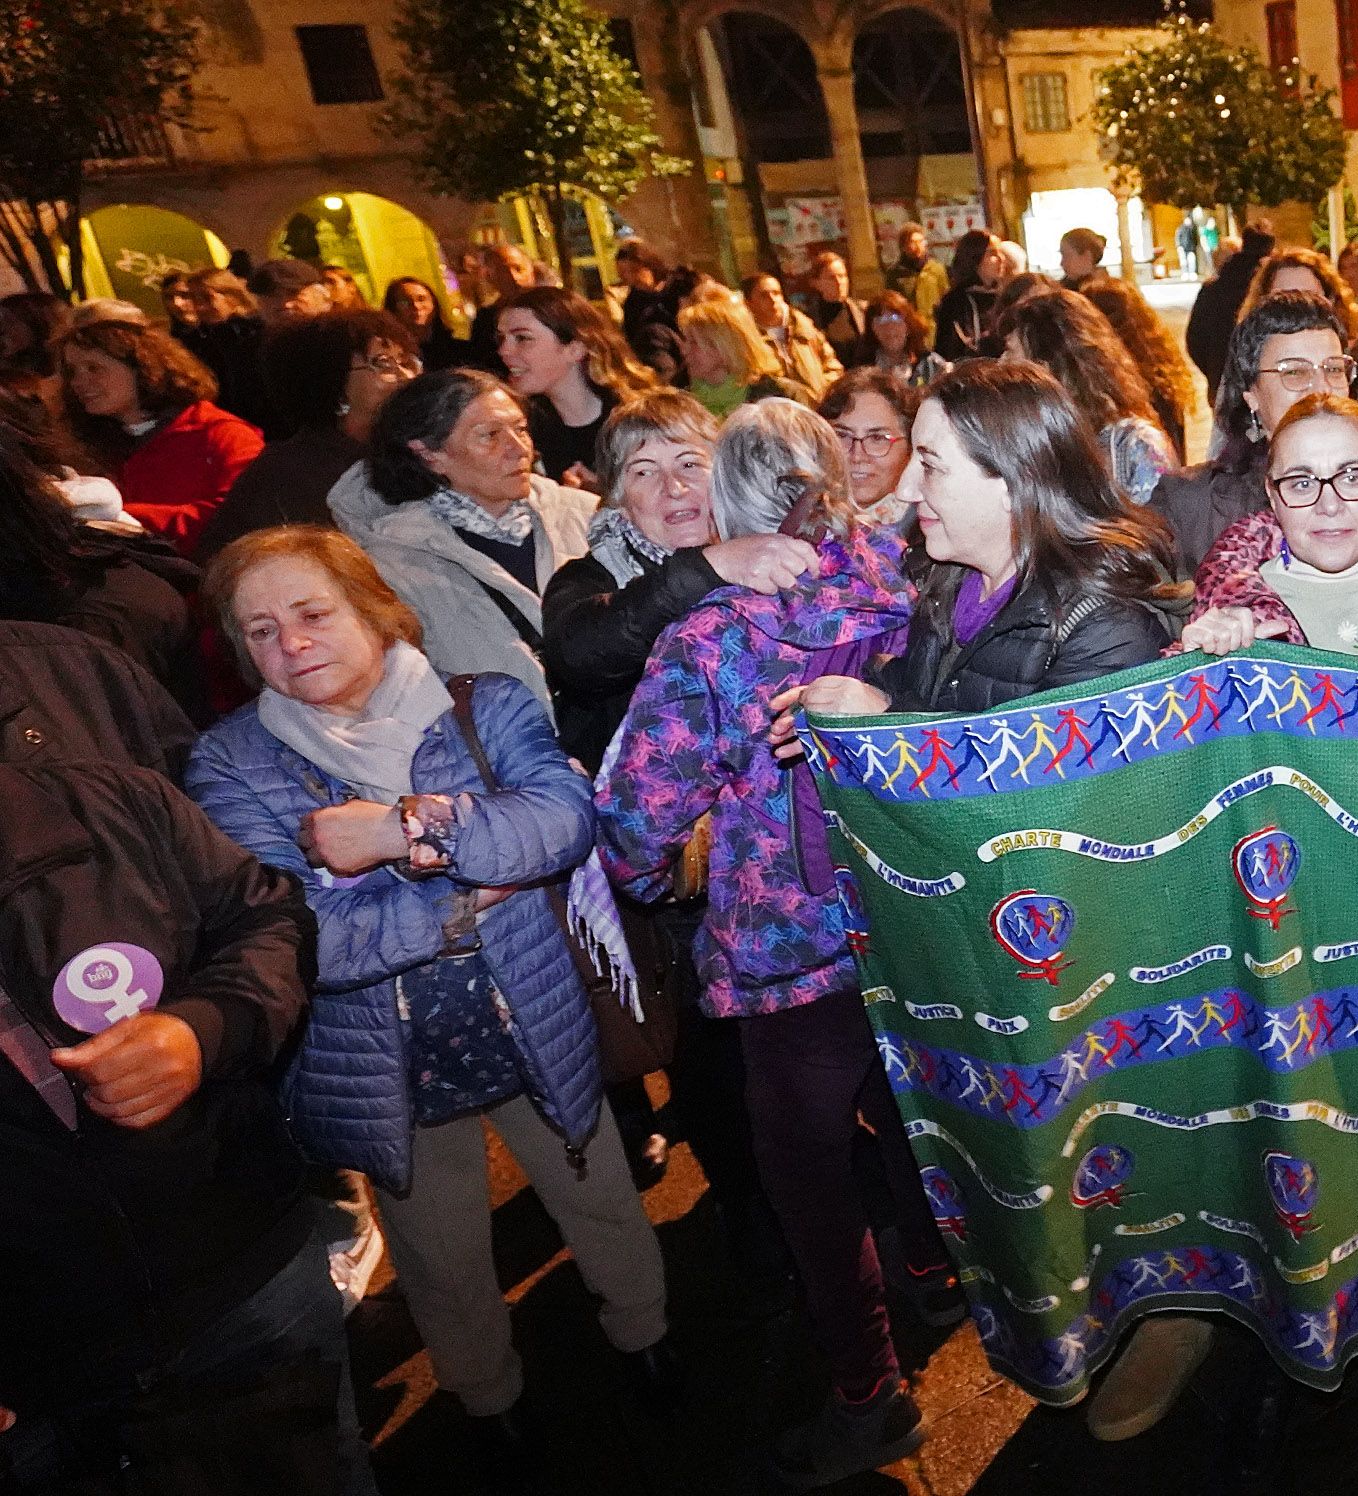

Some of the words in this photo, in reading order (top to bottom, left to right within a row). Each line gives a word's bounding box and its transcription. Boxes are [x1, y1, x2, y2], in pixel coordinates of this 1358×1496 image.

[991, 831, 1062, 856] CHARTE
[1079, 838, 1154, 861] MONDIALE
[1177, 814, 1208, 842] DES
[1216, 771, 1273, 808] FEMMES
[1290, 772, 1330, 807] POUR
[1136, 948, 1227, 981] SOLIDARITE
[1135, 1106, 1208, 1126] MONDIALE
